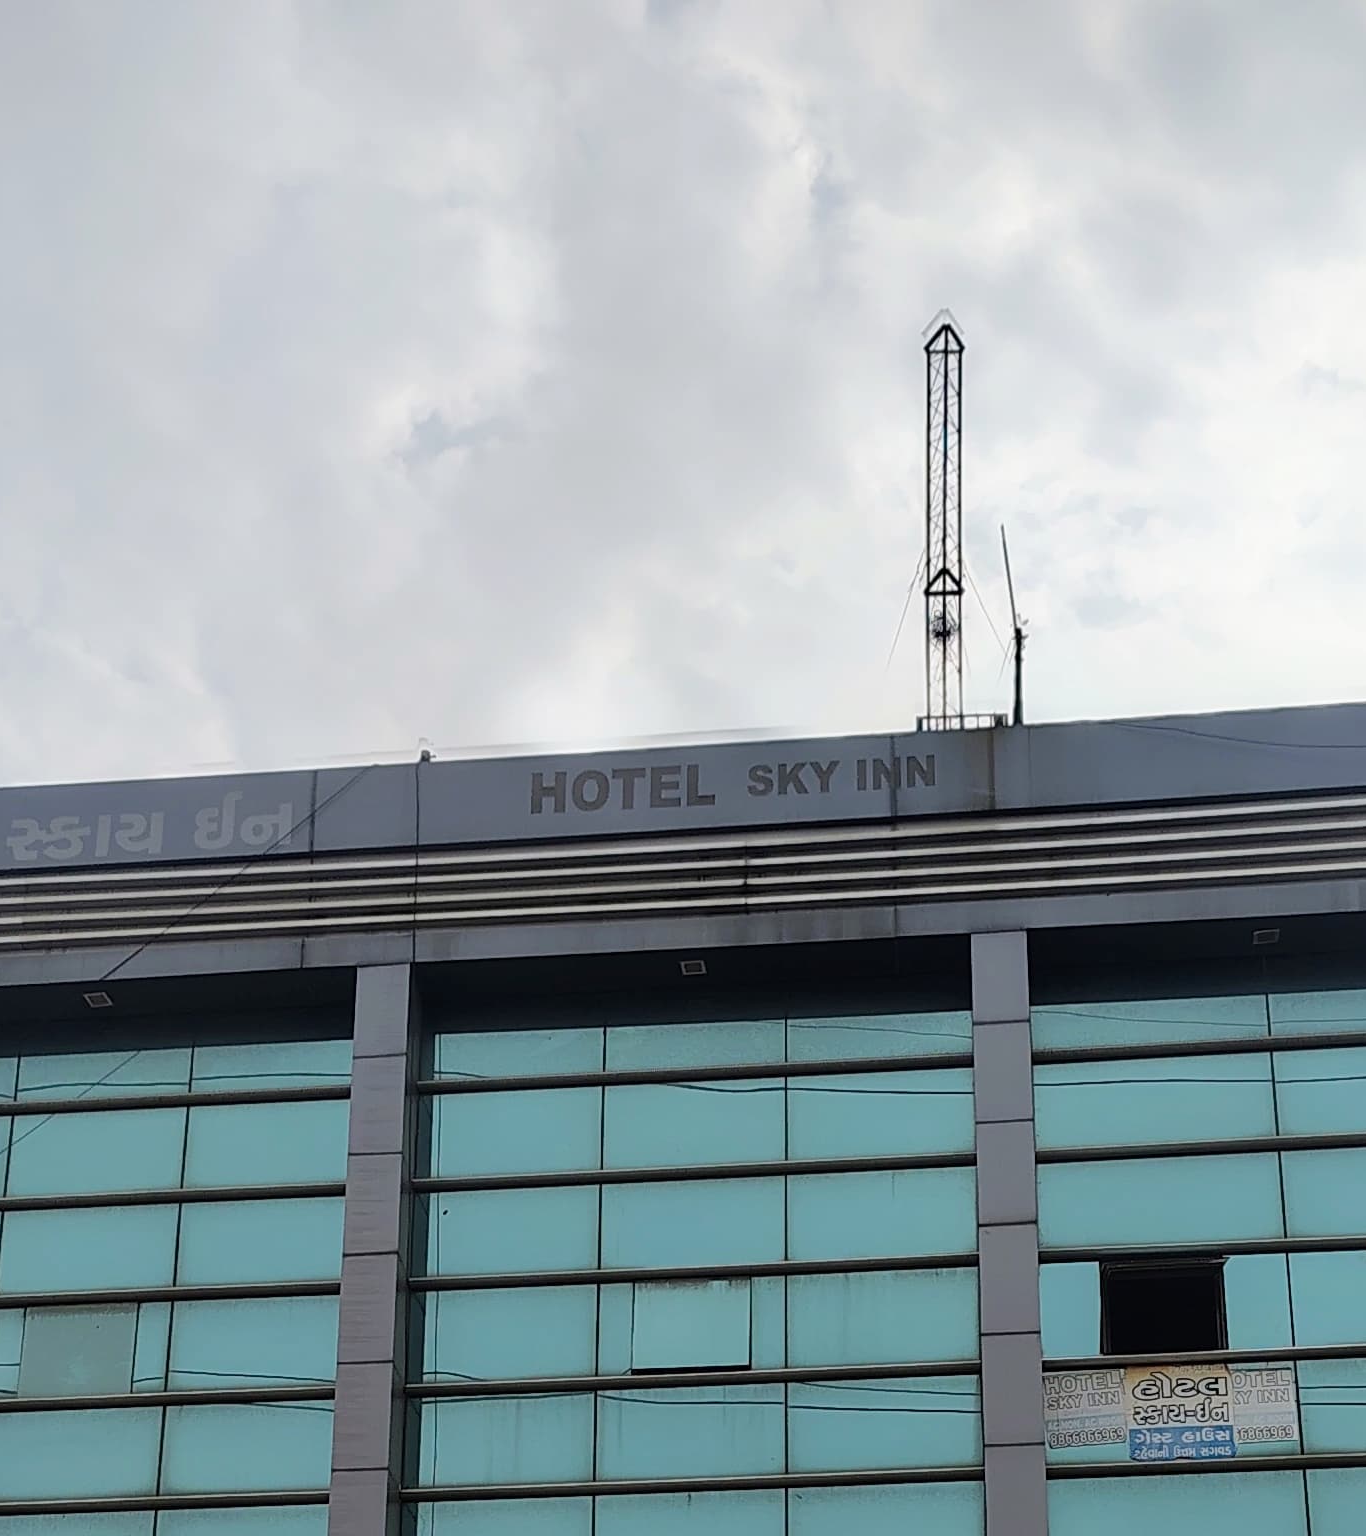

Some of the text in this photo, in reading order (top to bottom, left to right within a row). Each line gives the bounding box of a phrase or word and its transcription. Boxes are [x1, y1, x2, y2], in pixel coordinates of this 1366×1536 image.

[531, 754, 936, 815] HOTEL SKY INN
[1044, 1372, 1121, 1396] HOTEL
[1132, 1371, 1229, 1401] હોટલ
[1232, 1370, 1291, 1389] OTEL
[1047, 1390, 1121, 1411] SKY INN
